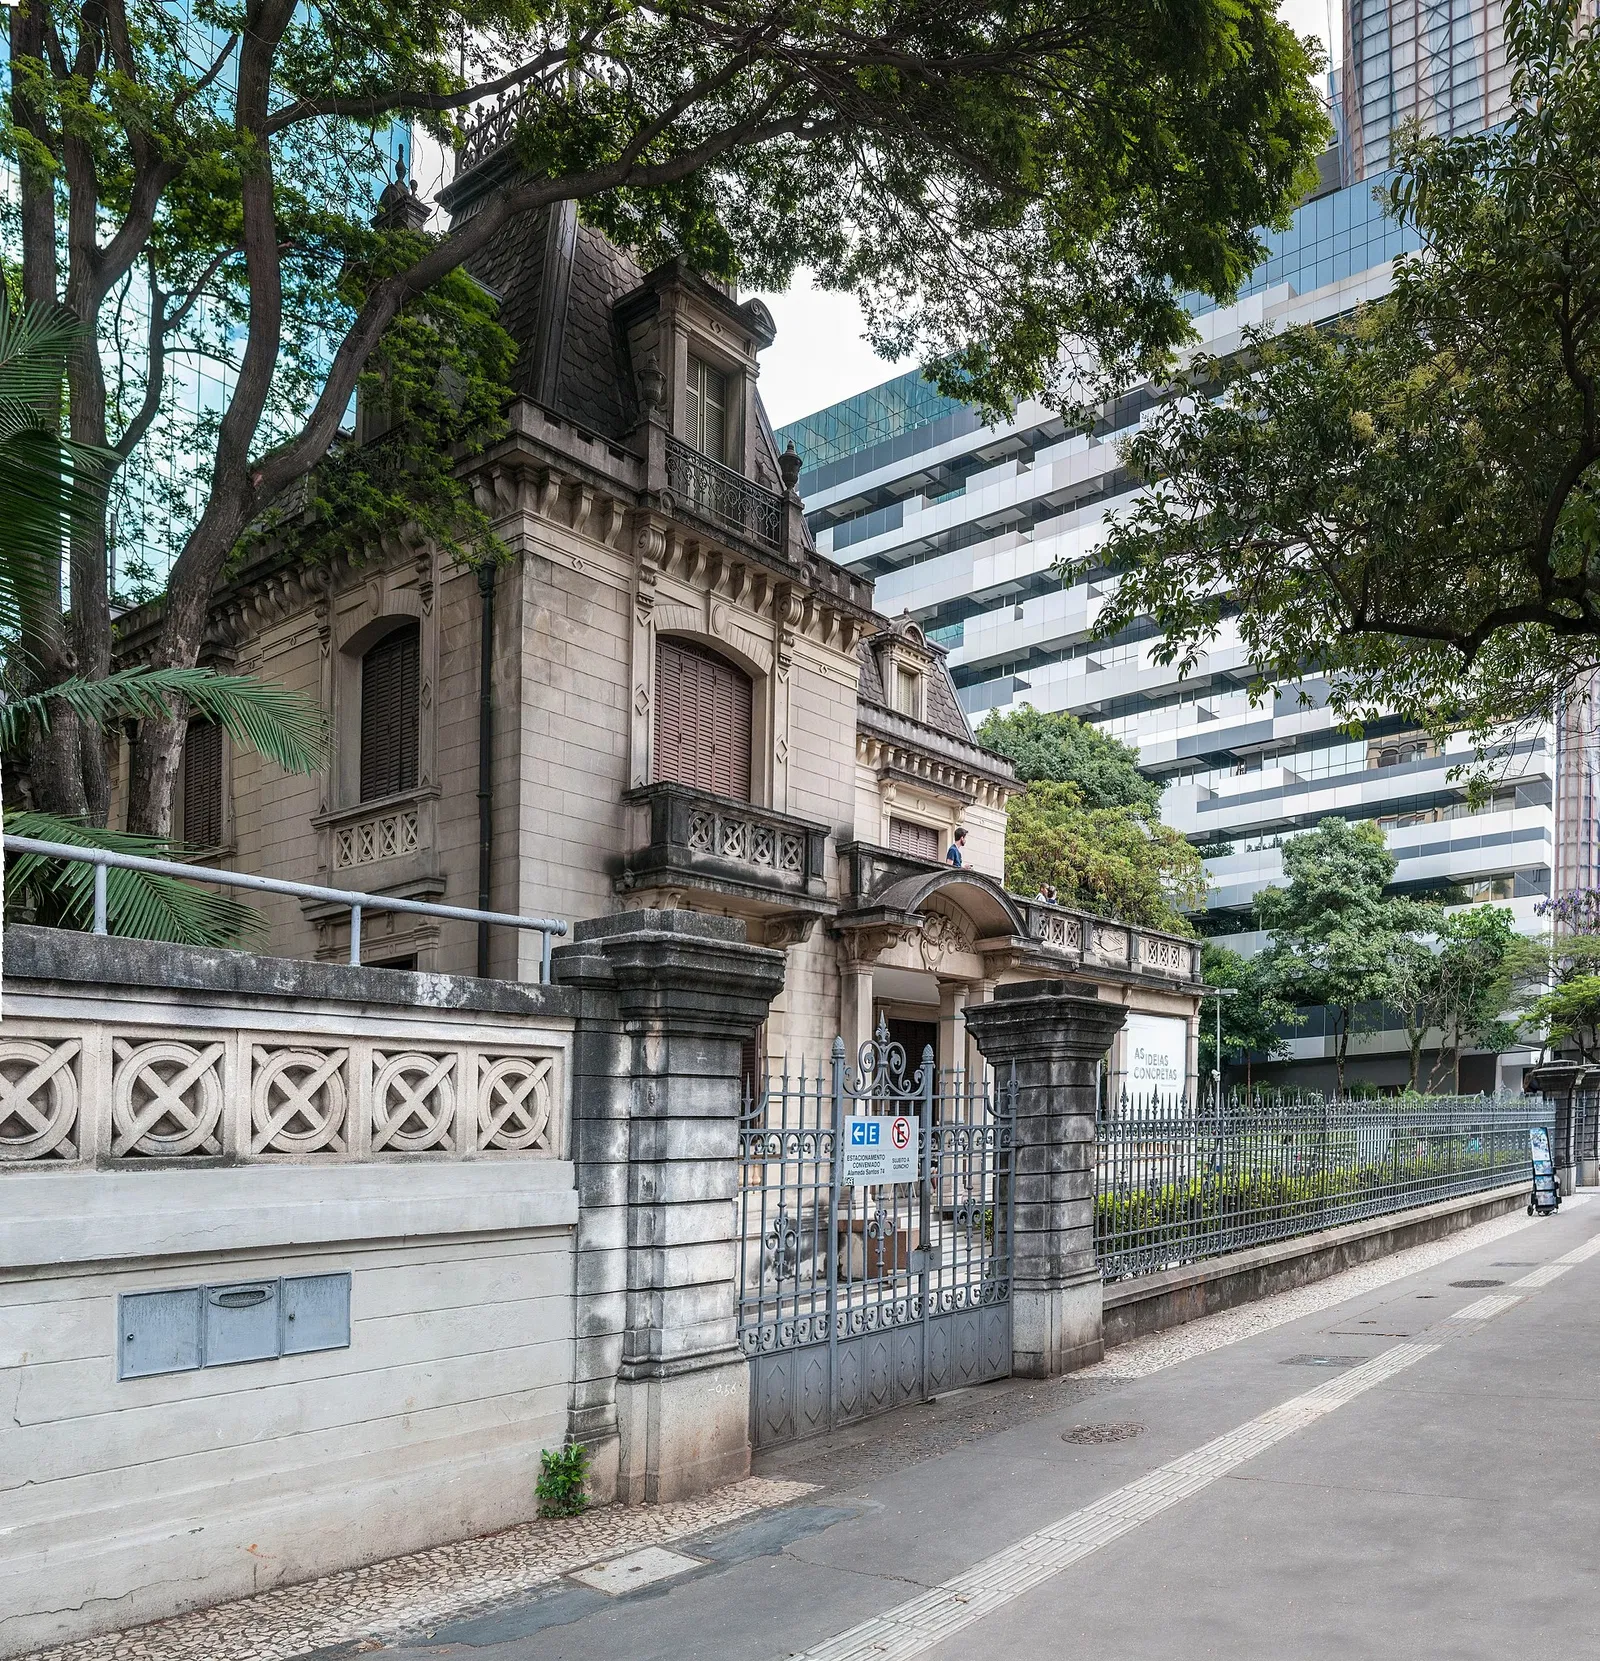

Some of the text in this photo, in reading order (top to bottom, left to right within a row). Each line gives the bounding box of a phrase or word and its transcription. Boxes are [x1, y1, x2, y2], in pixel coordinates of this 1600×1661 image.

[1134, 1047, 1169, 1067] AS IDEIAS
[1133, 1066, 1178, 1081] CONCRETAS
[869, 1125, 877, 1142] E
[897, 1123, 905, 1143] E
[846, 1153, 886, 1162] ESTACIONAMENTO
[852, 1161, 881, 1169] CONVENIADO
[865, 1168, 879, 1176] Santos
